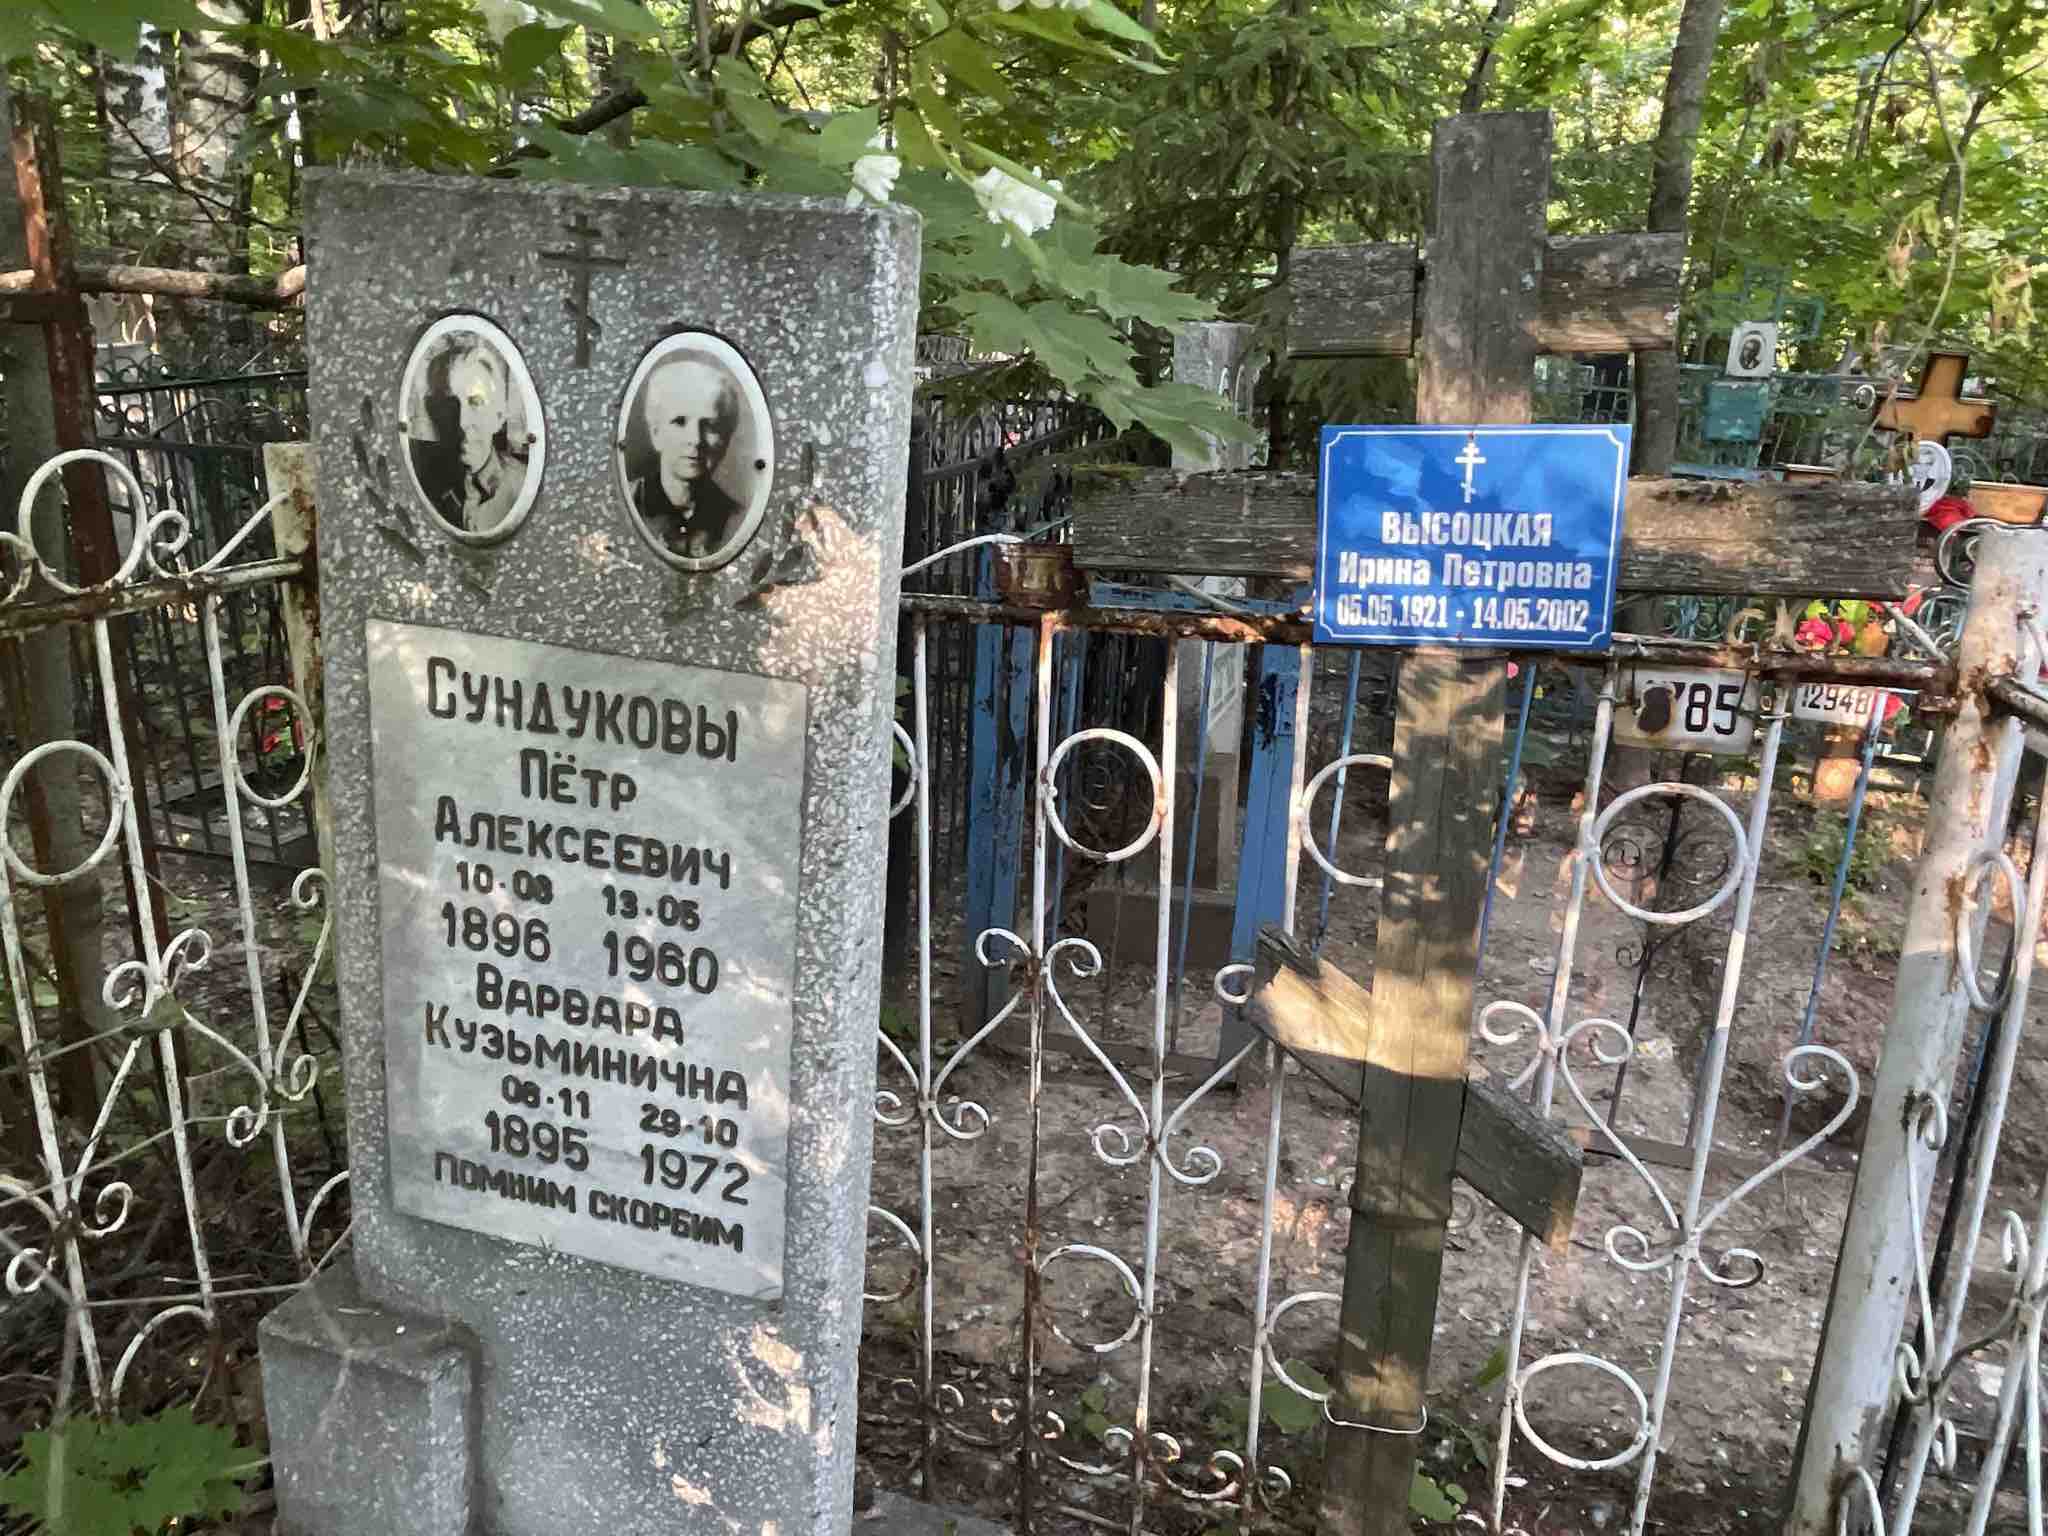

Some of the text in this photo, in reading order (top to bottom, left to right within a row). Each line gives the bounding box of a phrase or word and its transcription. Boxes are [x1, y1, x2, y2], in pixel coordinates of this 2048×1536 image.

[1381, 511, 1552, 550] ВЫСОЦКАЯ
[1338, 551, 1593, 592] Ирина Петровна
[1336, 593, 1448, 628] 05.05.1921
[1471, 596, 1589, 633] 14.05.2002
[1633, 680, 1740, 735] 85
[442, 902, 719, 995] 1896 1960
[485, 1110, 750, 1205] 1895 1972
[435, 1151, 744, 1253] ПОМНИМ СКОРБИМ
